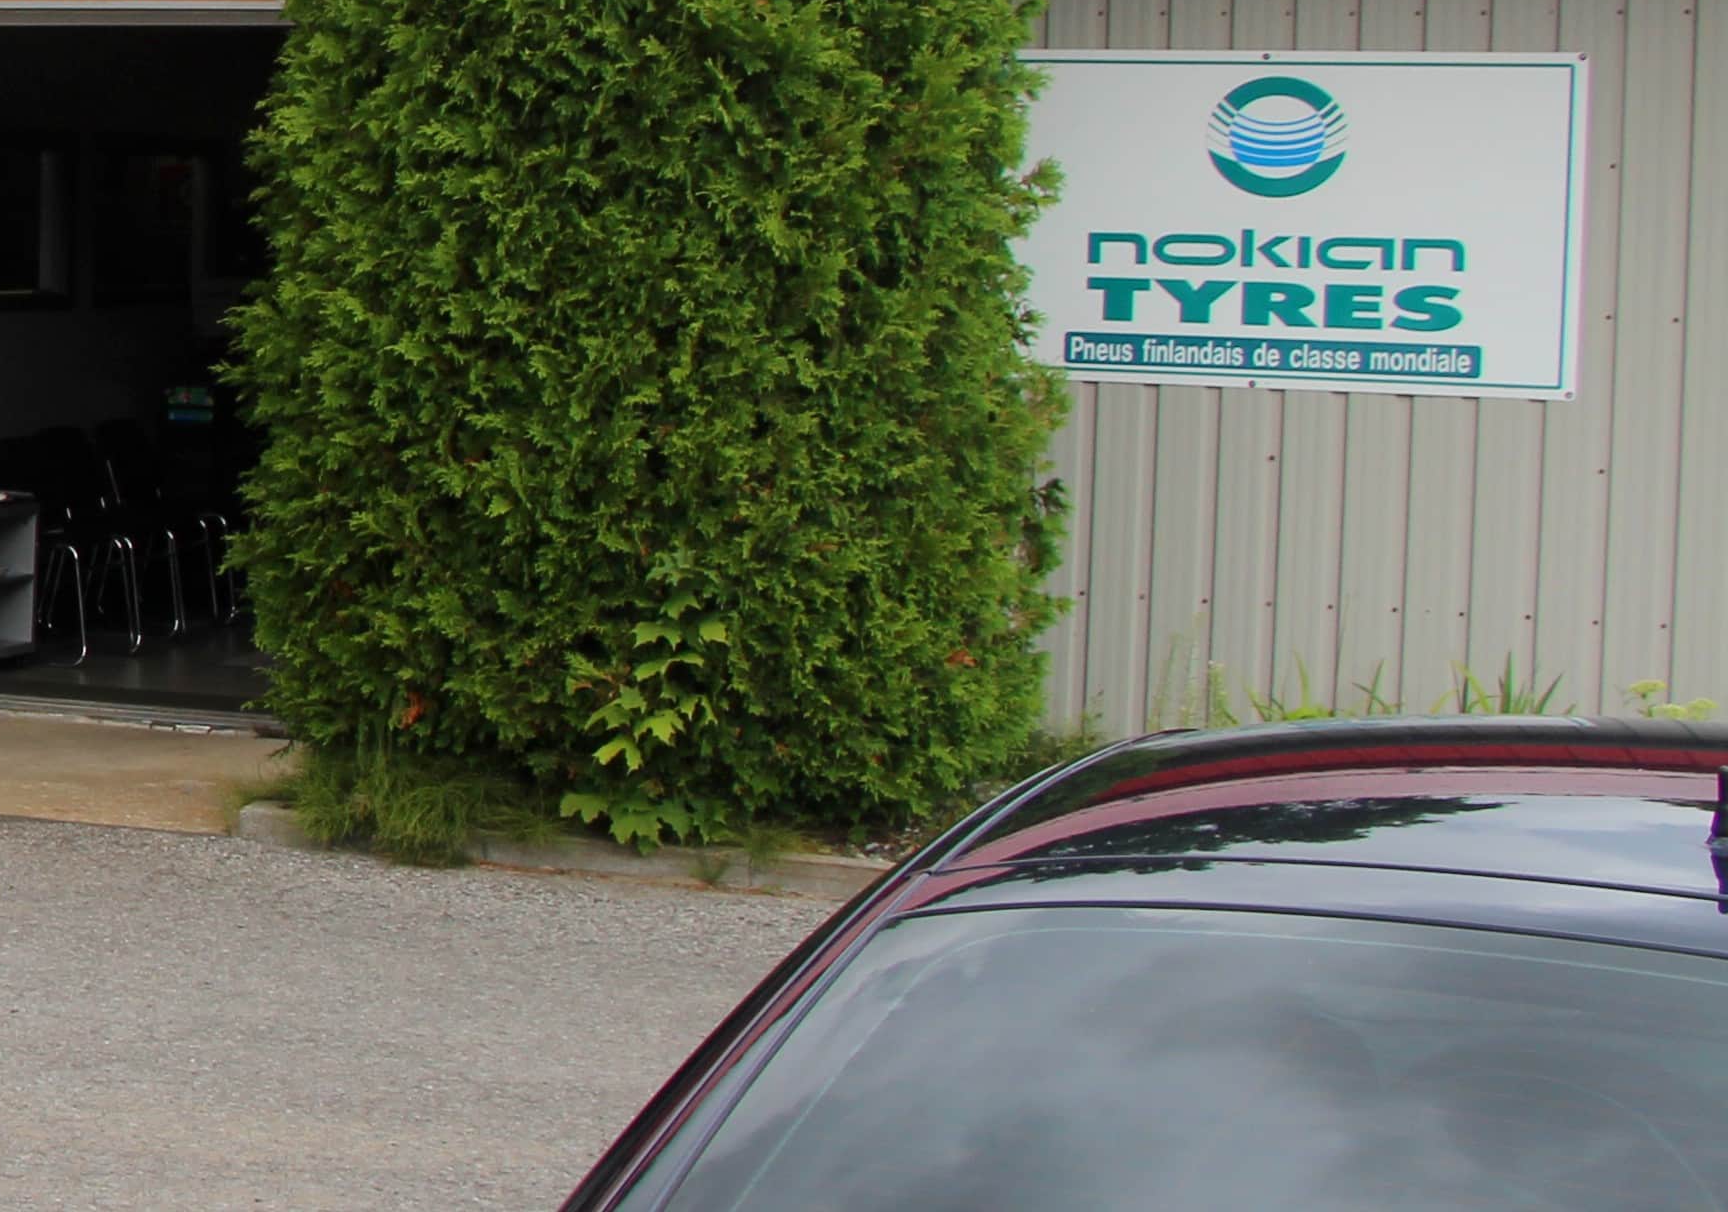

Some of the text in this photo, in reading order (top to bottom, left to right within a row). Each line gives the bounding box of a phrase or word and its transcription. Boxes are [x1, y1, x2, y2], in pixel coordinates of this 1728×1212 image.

[1087, 277, 1464, 332] TYRES
[1070, 336, 1472, 374] Pneus finlandais de classe mondiale
